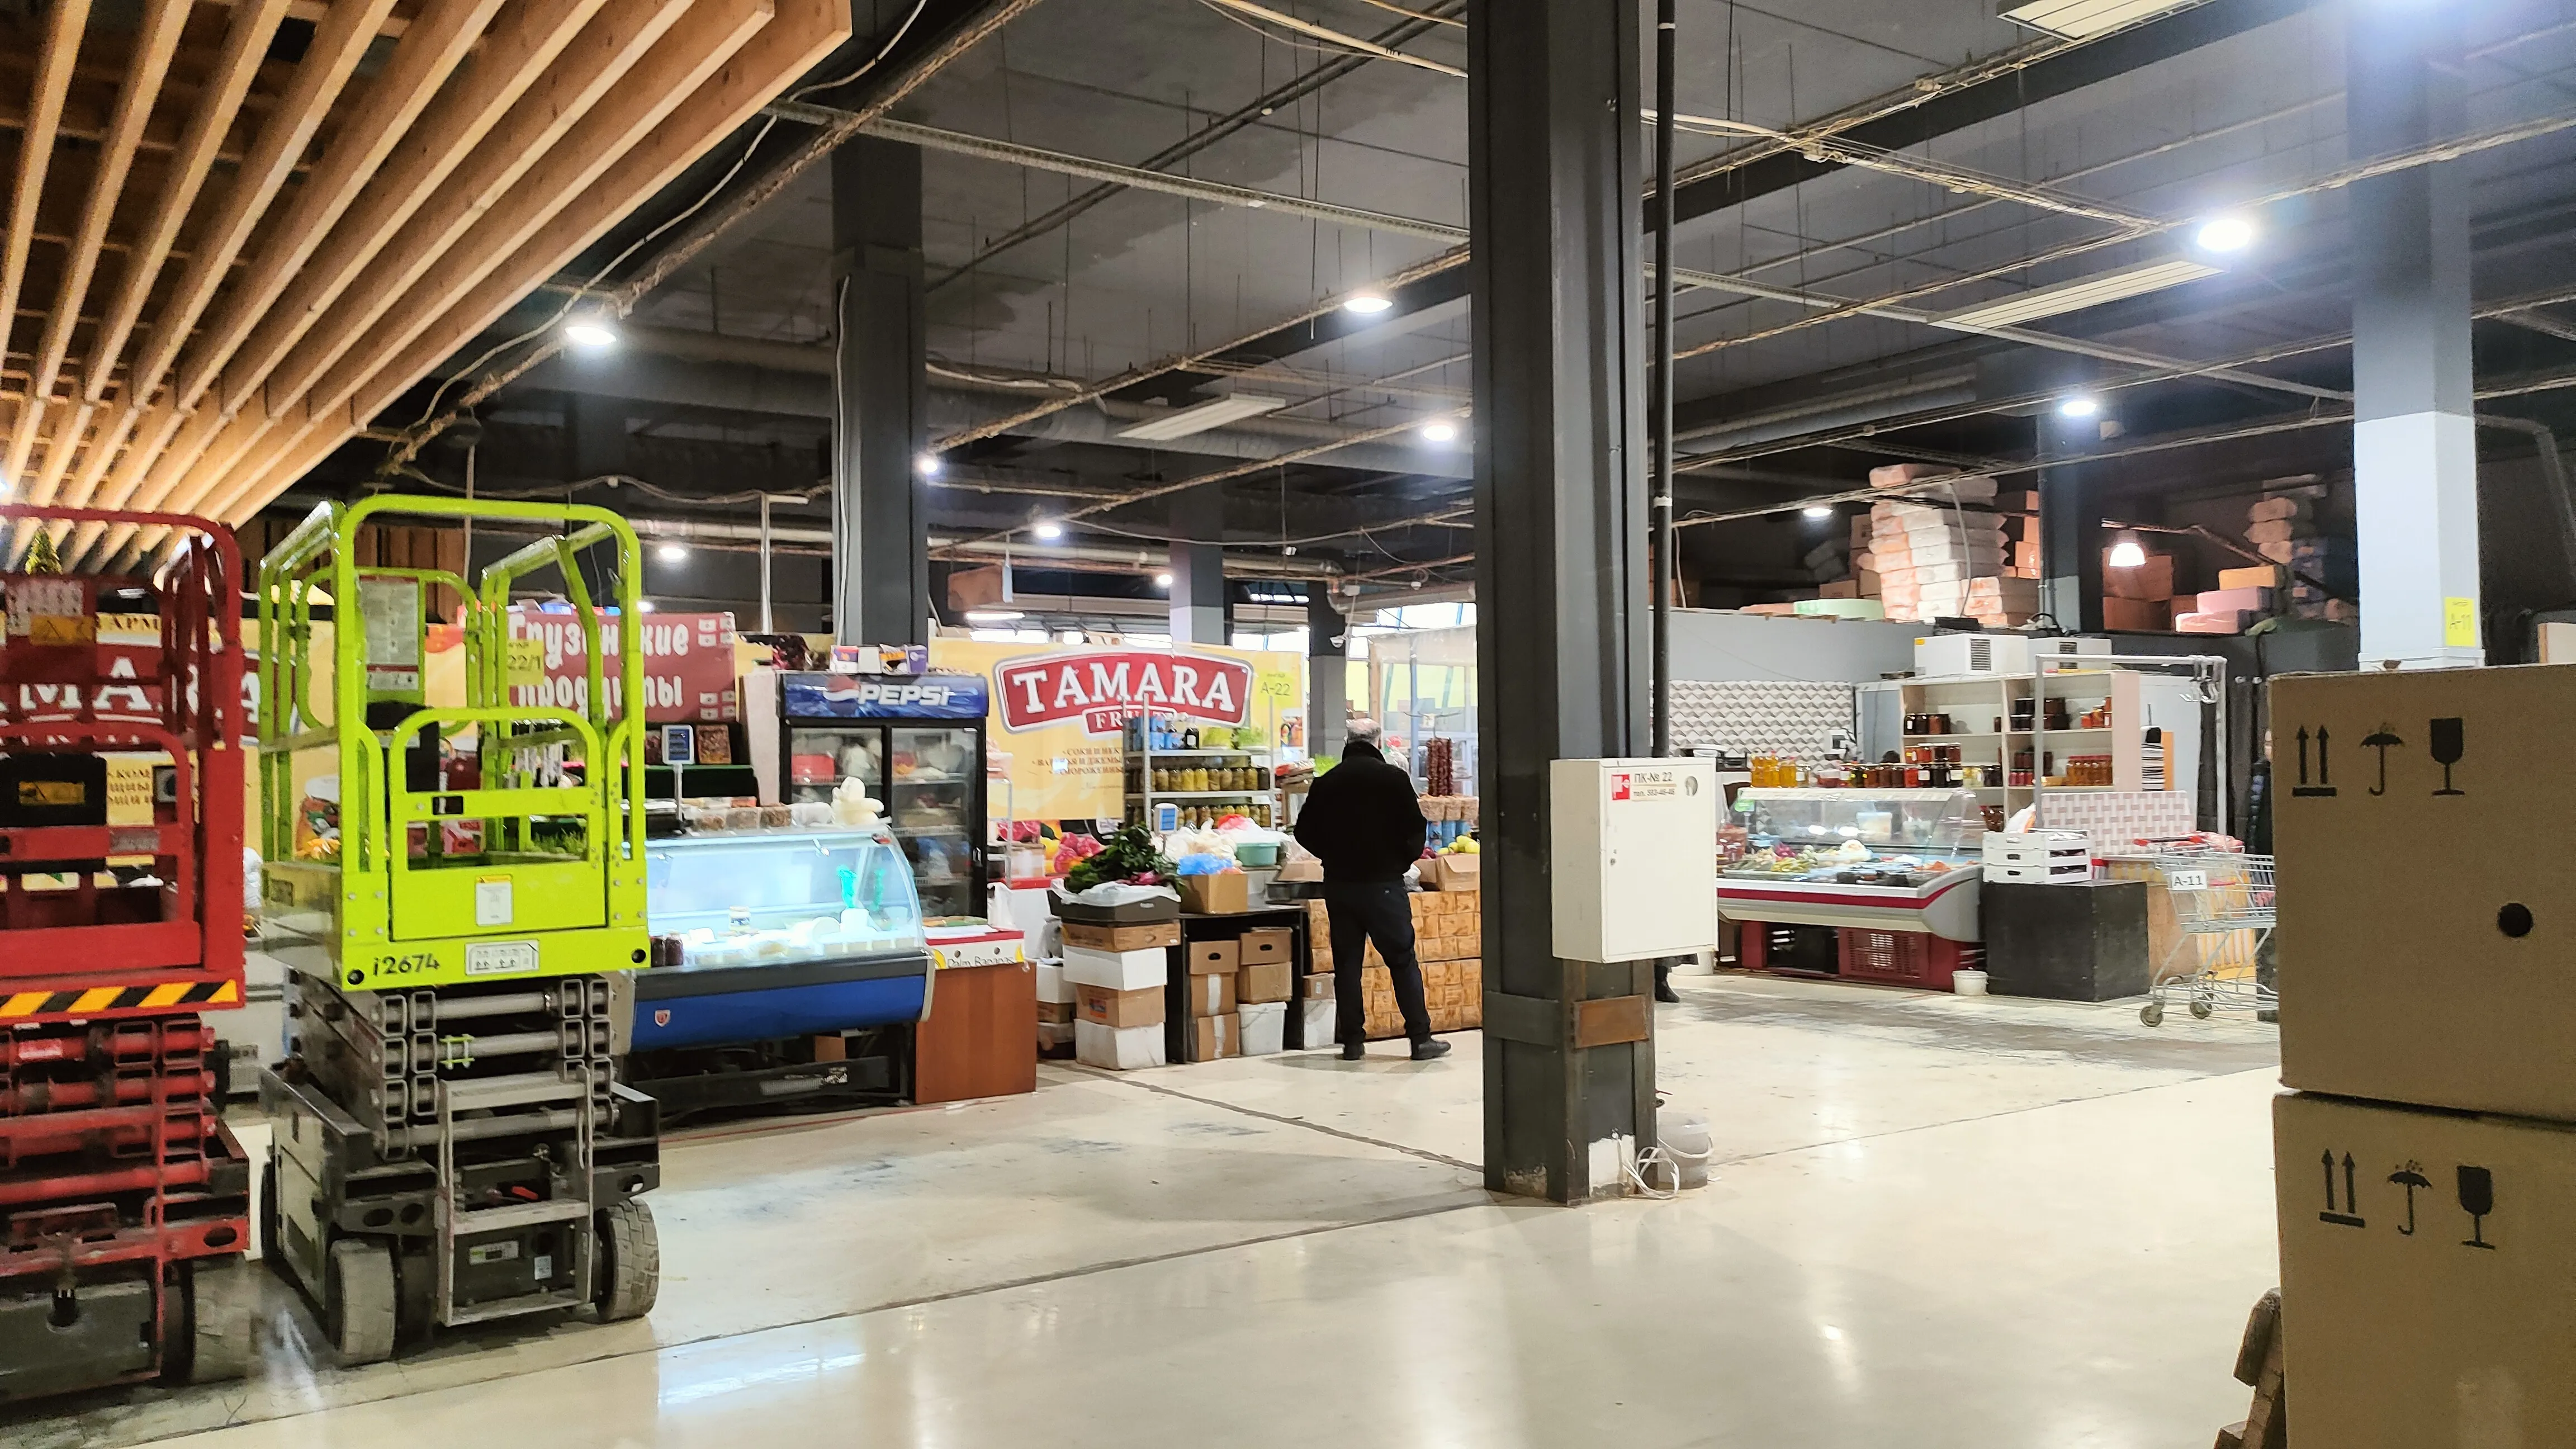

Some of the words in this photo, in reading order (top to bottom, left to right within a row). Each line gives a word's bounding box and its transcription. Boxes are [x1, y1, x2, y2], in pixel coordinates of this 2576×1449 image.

[858, 684, 951, 705] PEPSI
[1012, 662, 1235, 713] TAMARA
[1662, 771, 1673, 782] 22
